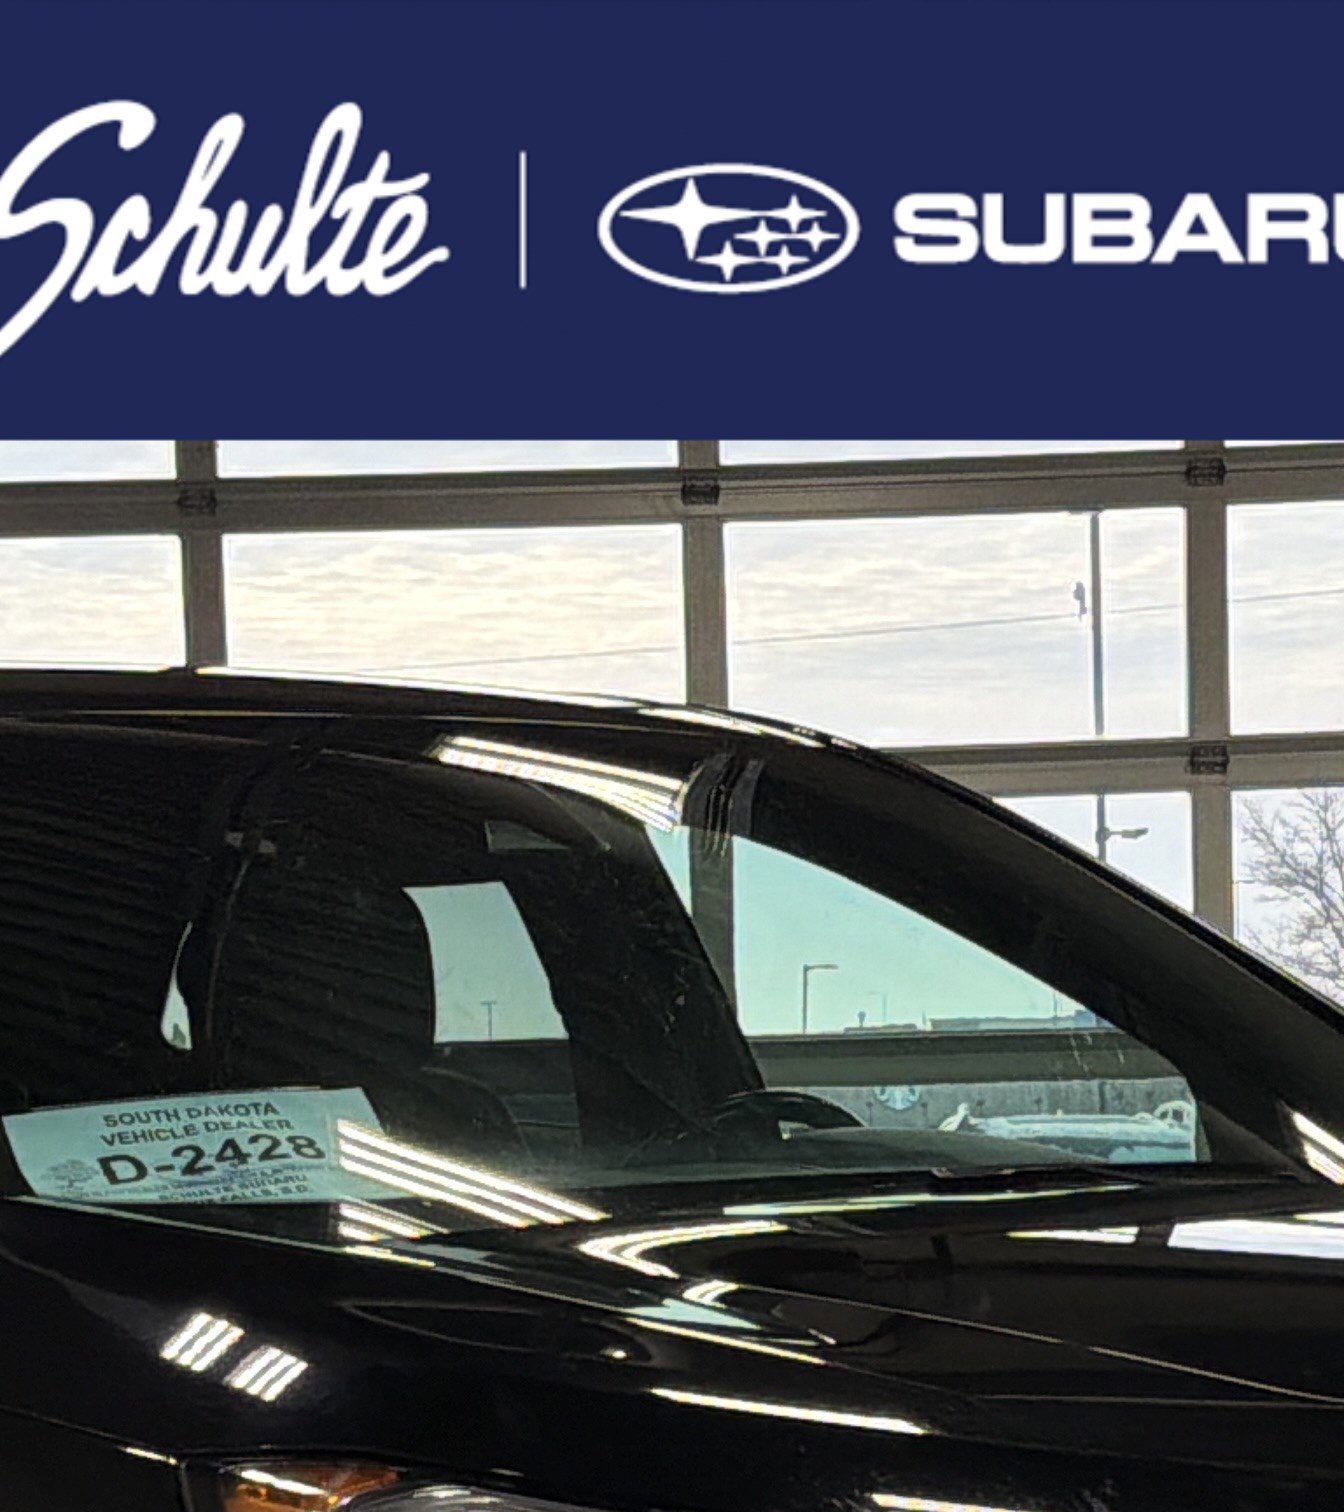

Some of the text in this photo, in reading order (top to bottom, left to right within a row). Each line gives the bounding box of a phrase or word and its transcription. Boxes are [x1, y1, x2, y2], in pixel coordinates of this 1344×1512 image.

[102, 1101, 280, 1128] SOUTH DAKOTA
[100, 1119, 295, 1147] VEHICLE DEALER
[96, 1133, 326, 1185] D-2428
